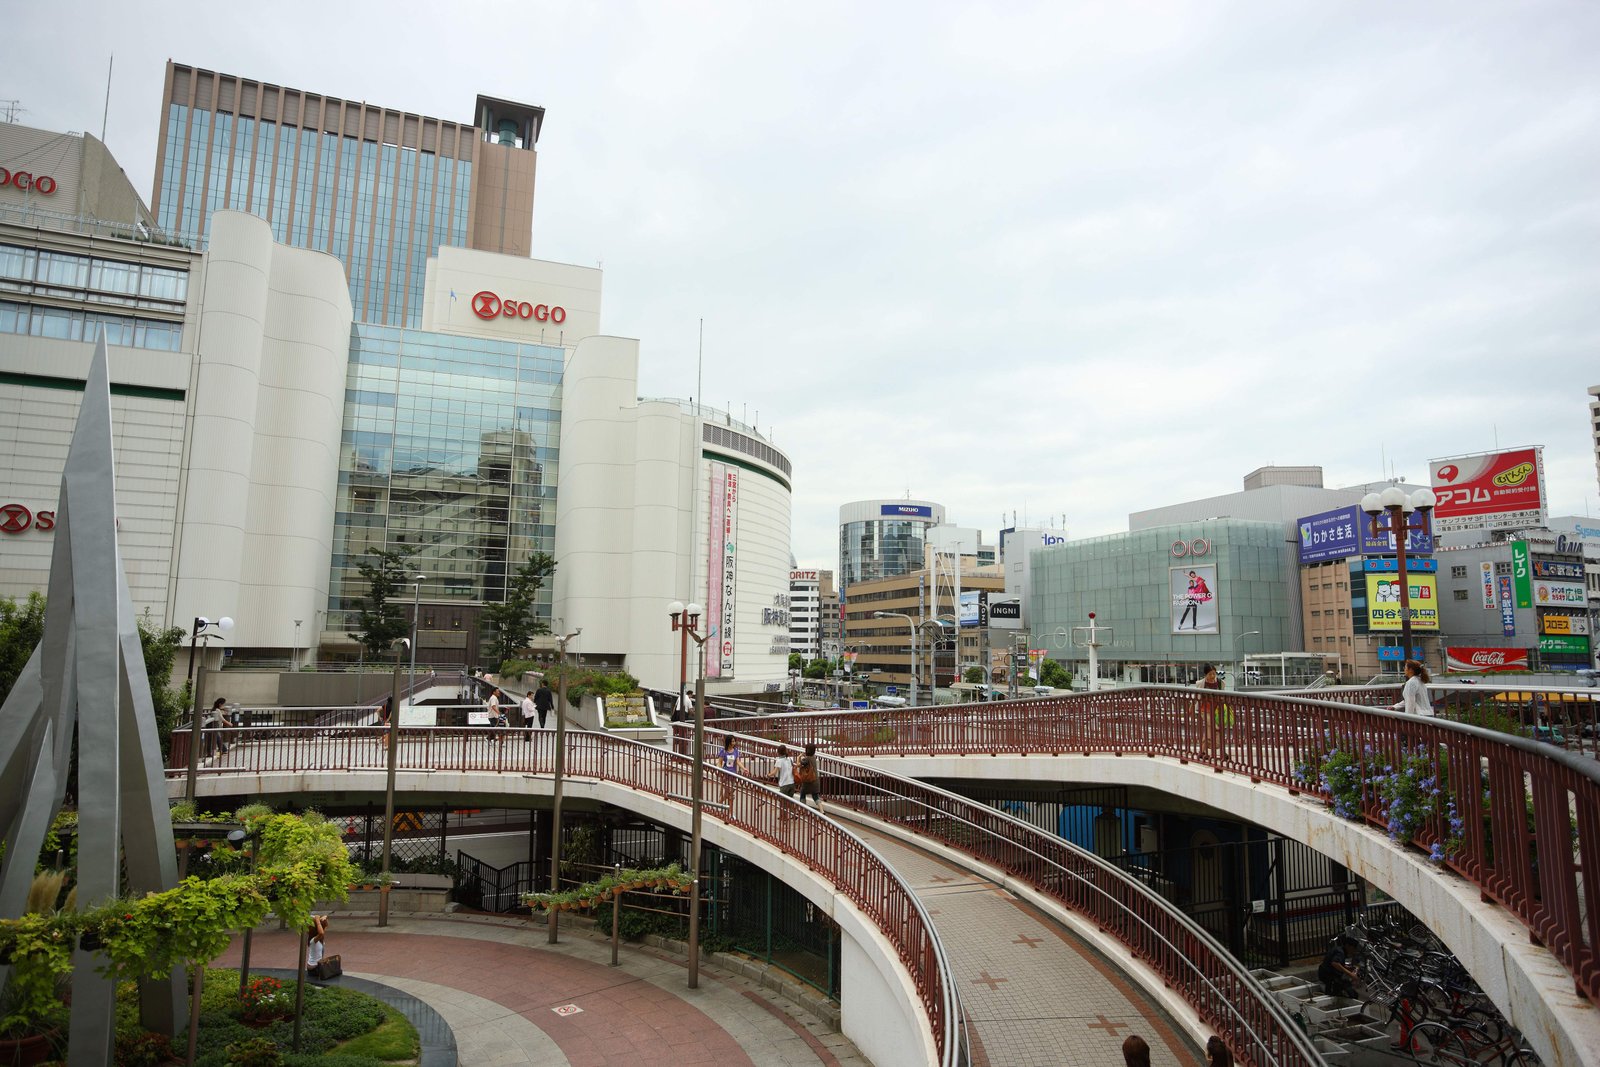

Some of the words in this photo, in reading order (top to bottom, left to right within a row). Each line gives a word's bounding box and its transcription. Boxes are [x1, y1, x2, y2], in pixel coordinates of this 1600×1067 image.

[502, 299, 567, 324] SOGO
[1435, 487, 1492, 507] アコム
[1313, 523, 1352, 544] わかさ生活
[1530, 537, 1556, 545] PACHINKO
[1555, 534, 1584, 553] GAIA
[1515, 549, 1526, 578] レイク
[790, 571, 816, 579] ORITZ
[724, 555, 734, 639] 阪神なんば線
[1565, 588, 1584, 602] 広場
[1545, 620, 1569, 629] プロミス
